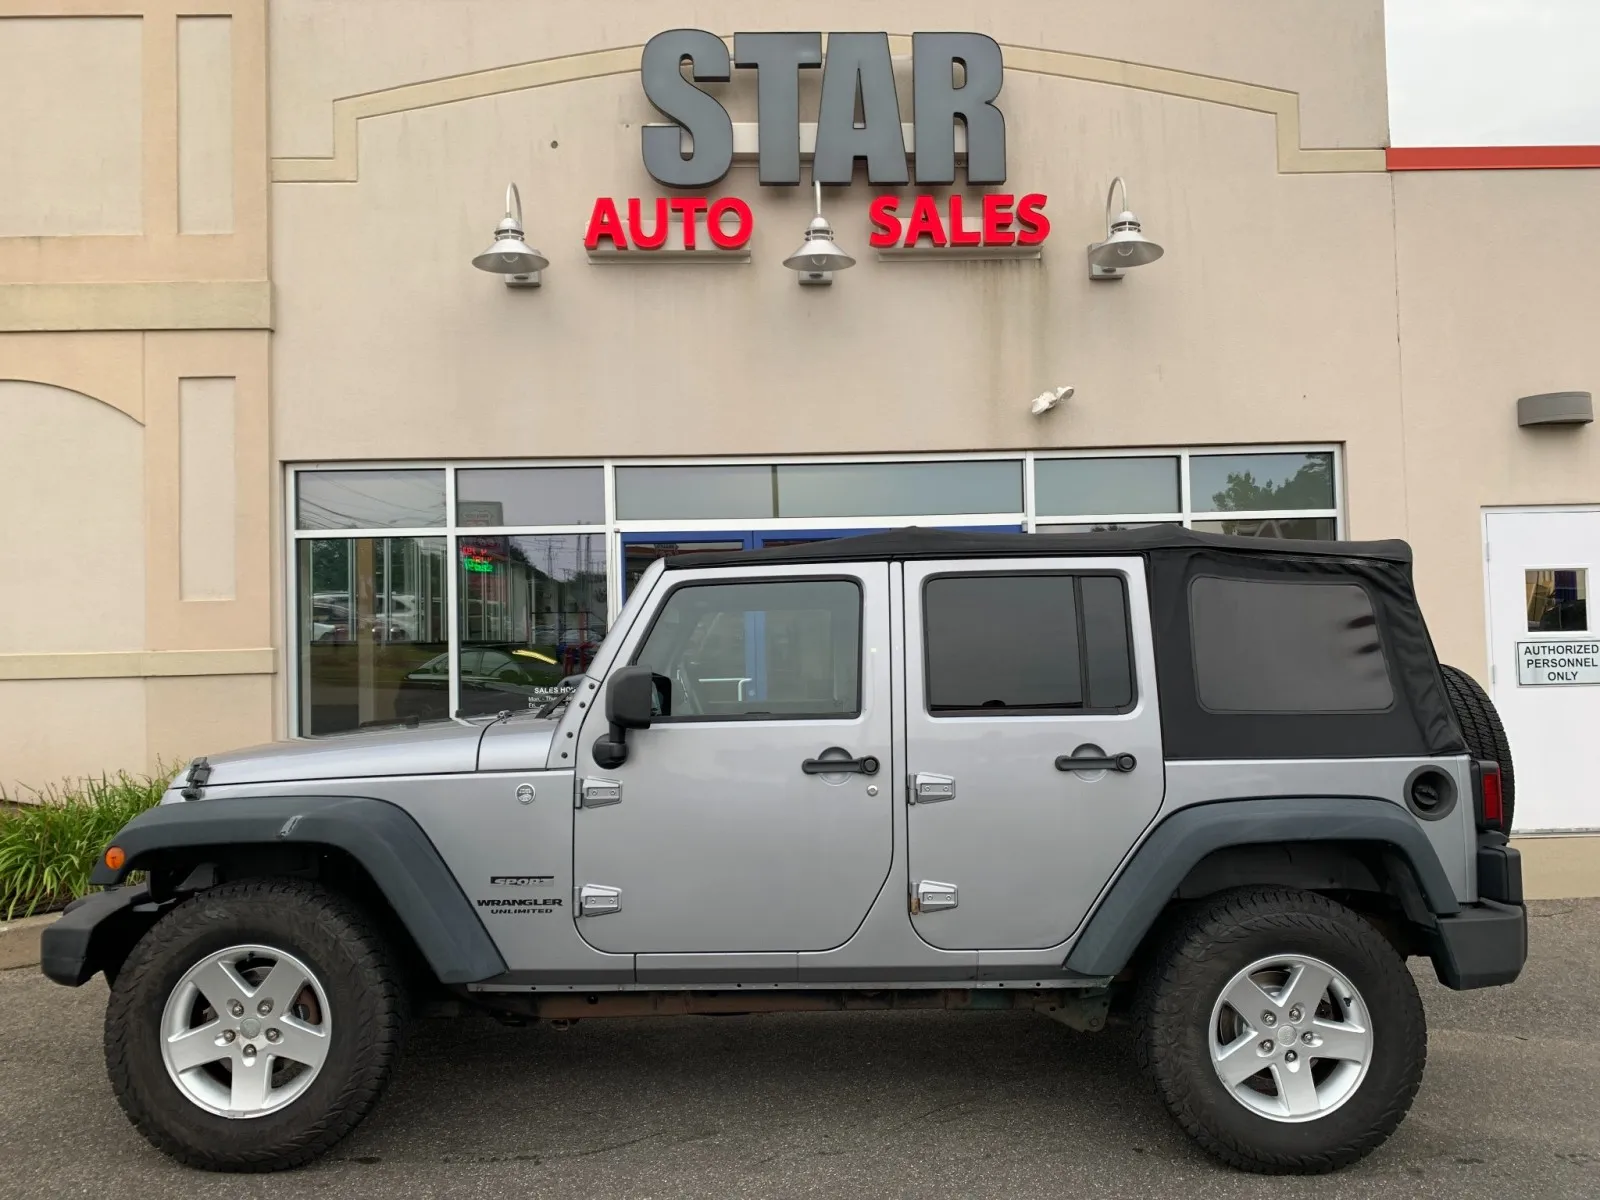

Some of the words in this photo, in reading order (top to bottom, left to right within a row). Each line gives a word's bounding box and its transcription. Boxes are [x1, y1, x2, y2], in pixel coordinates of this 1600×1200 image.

[641, 28, 1006, 187] STAR
[584, 197, 753, 250] AUTO
[869, 193, 1051, 248] SALES
[1524, 644, 1599, 655] AUTHORIZED
[1526, 657, 1599, 668] PERSONNEL
[1547, 671, 1579, 681] ONLY
[560, 686, 576, 694] HOU
[477, 898, 563, 907] WRANGLER
